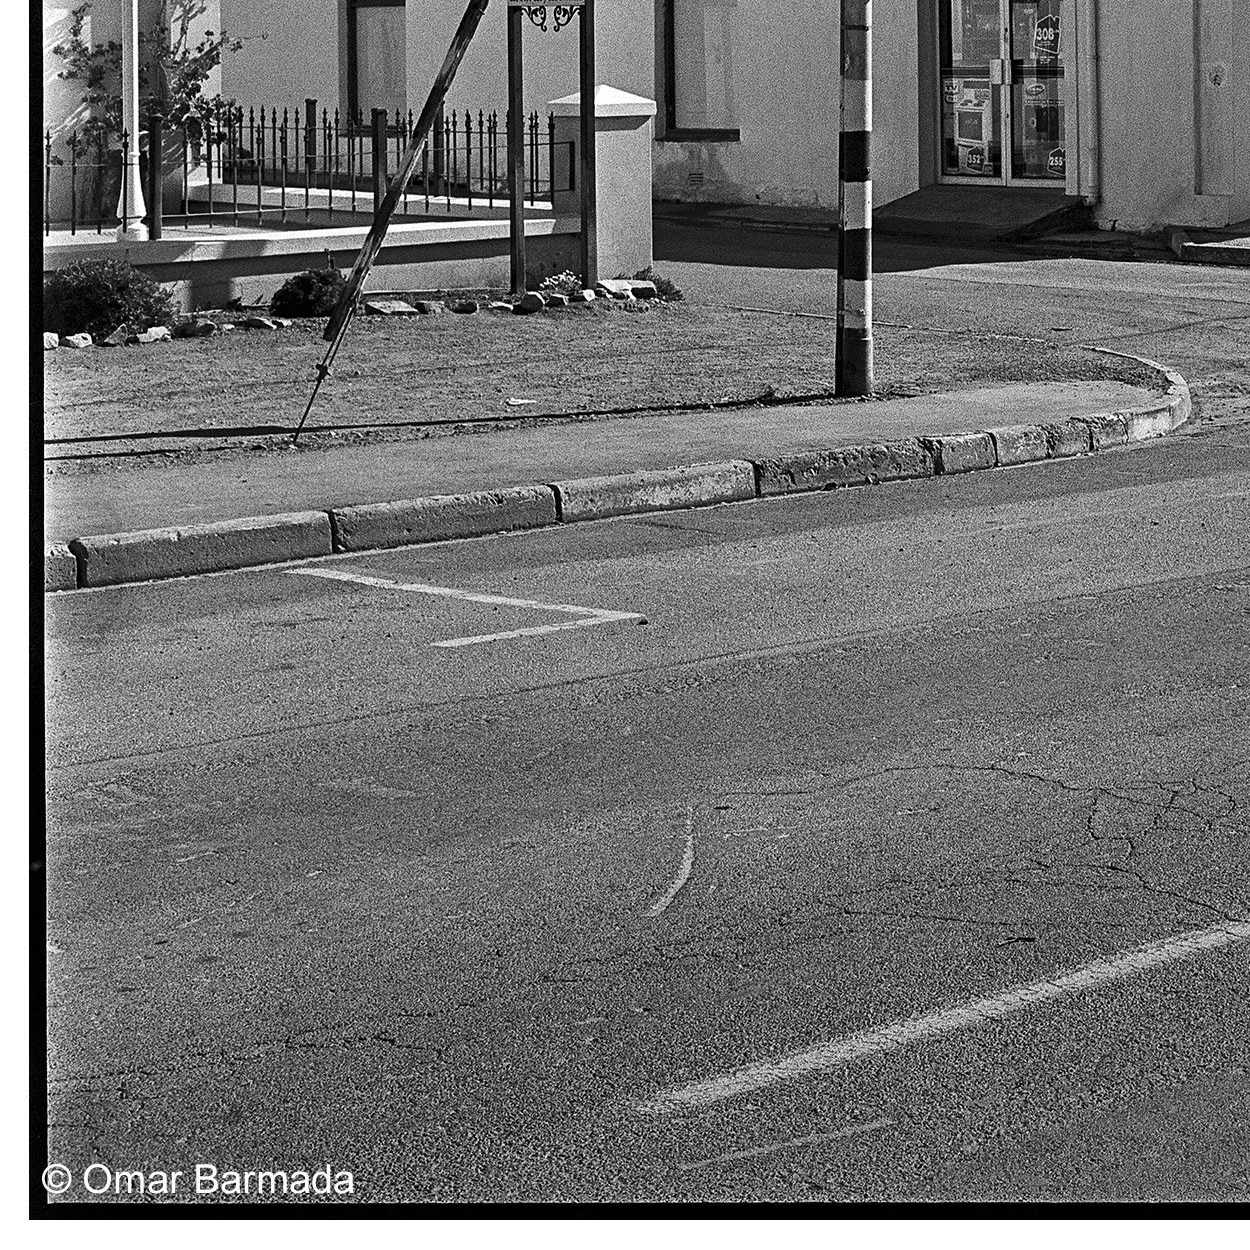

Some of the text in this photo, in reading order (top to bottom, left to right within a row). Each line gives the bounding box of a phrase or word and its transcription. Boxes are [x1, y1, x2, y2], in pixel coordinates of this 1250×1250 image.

[1036, 27, 1055, 40] 308
[967, 154, 980, 164] 352
[1049, 156, 1063, 166] 255
